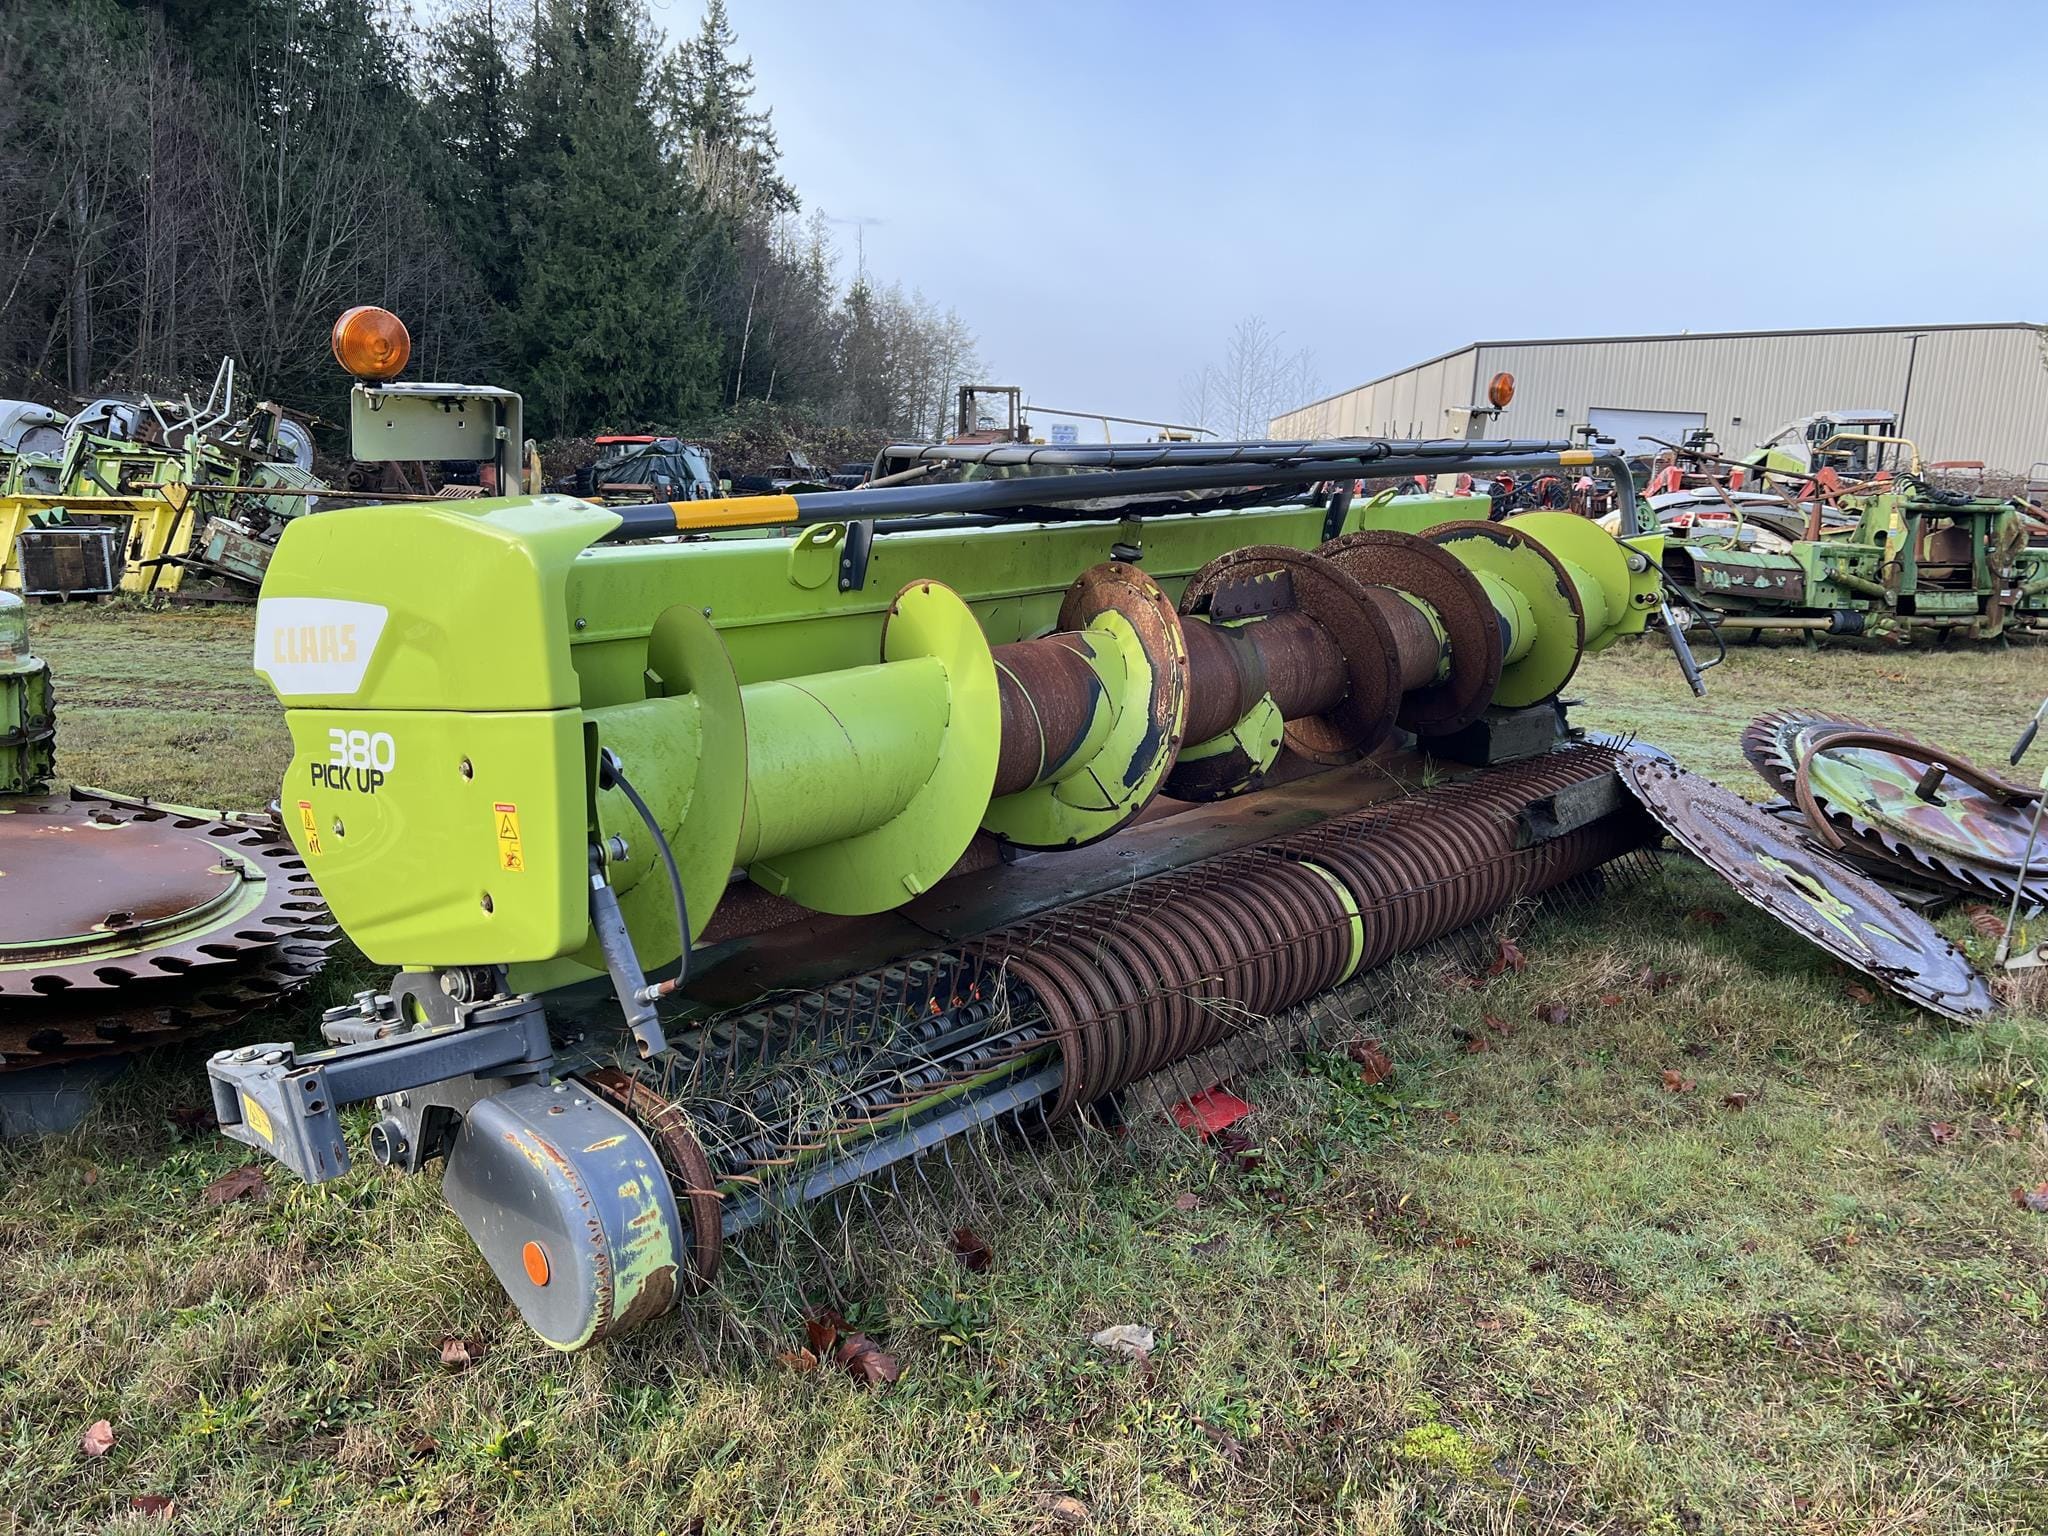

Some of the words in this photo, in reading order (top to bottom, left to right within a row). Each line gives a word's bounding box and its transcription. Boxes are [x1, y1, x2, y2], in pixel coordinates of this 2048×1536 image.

[273, 624, 358, 664] CLAAS
[329, 728, 396, 772] 380
[310, 762, 352, 791] PICK
[356, 768, 385, 794] UP
